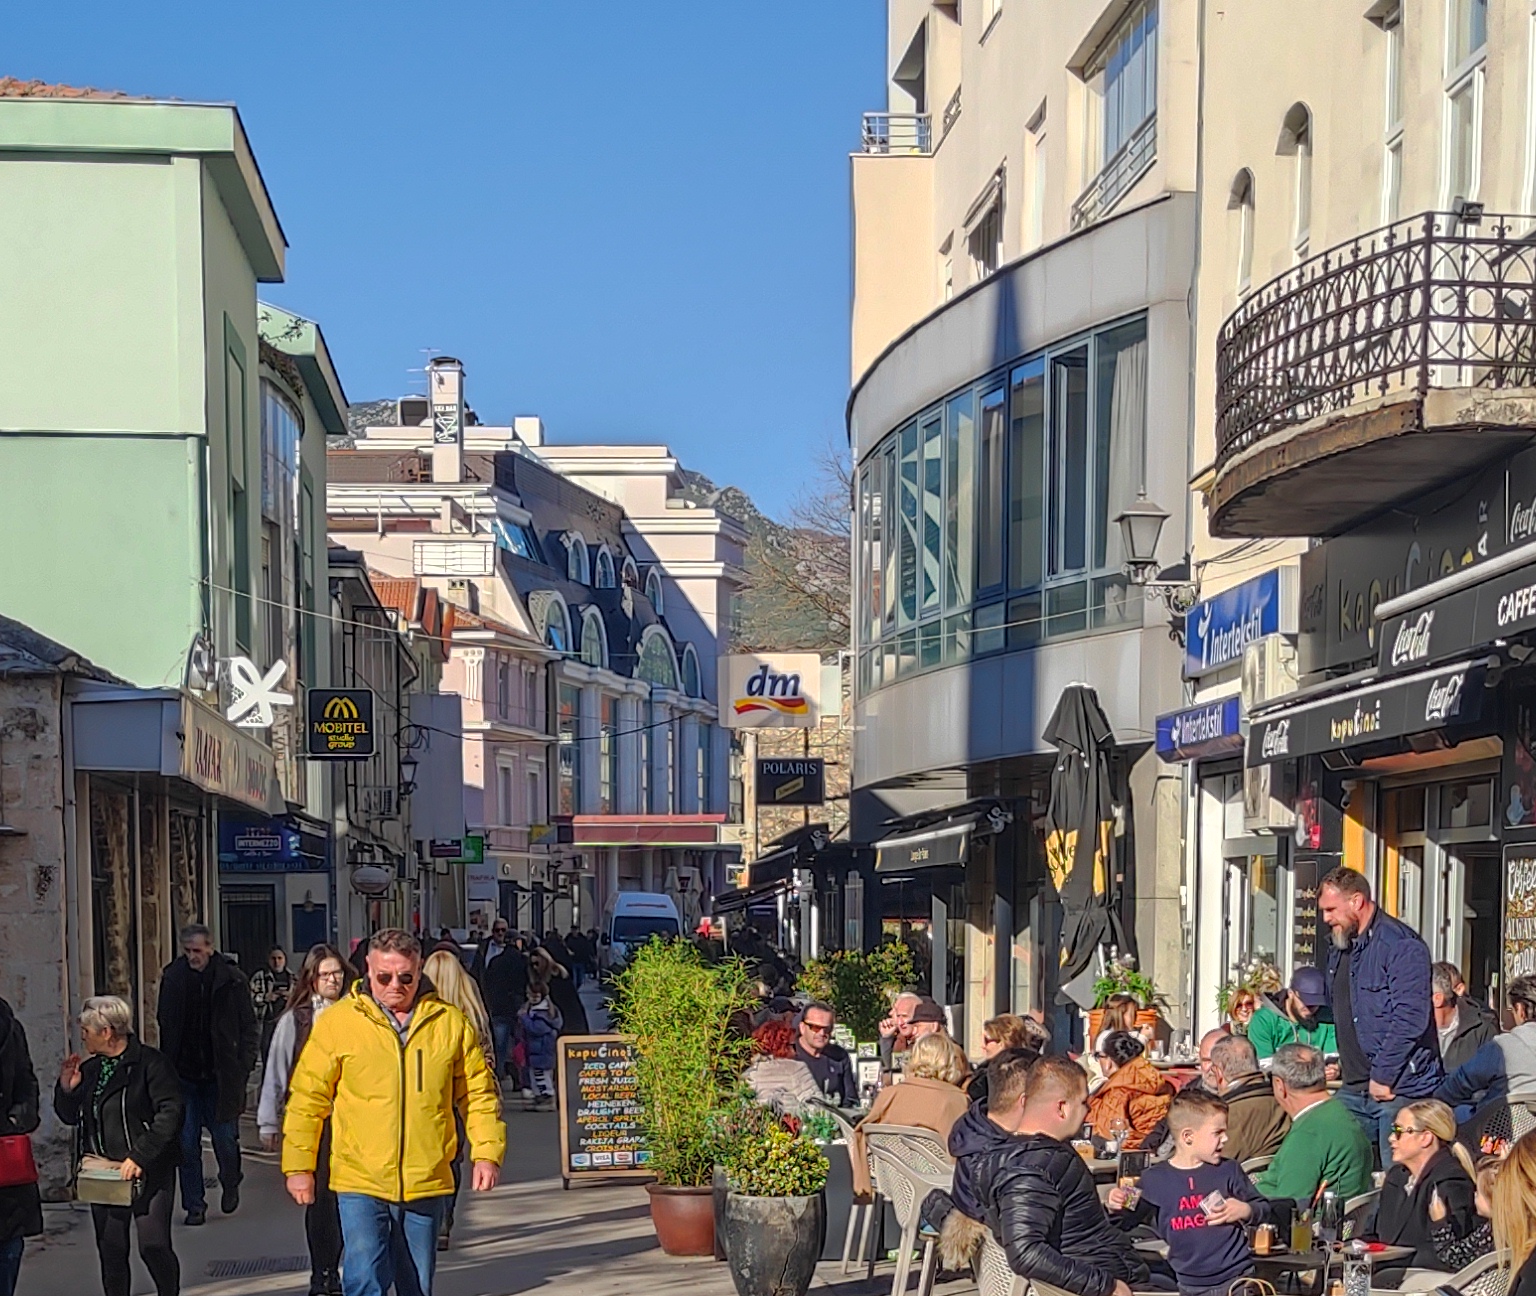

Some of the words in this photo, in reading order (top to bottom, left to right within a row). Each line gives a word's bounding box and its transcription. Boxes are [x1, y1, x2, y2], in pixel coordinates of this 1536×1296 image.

[1497, 585, 1536, 626] CAFFE
[746, 664, 800, 697] dm
[314, 721, 369, 734] MOBITEL
[763, 763, 817, 775] POLARIS
[583, 1061, 606, 1070] ICED
[610, 1069, 623, 1077] TO
[578, 1077, 608, 1086] FRESH
[614, 1091, 636, 1100] BEER
[577, 1108, 621, 1116] DRAUGHT
[584, 1122, 636, 1131] COCKTAILS
[579, 1137, 615, 1146] RAKIJA
[1179, 1194, 1203, 1211] AM
[1171, 1213, 1206, 1230] MAG
